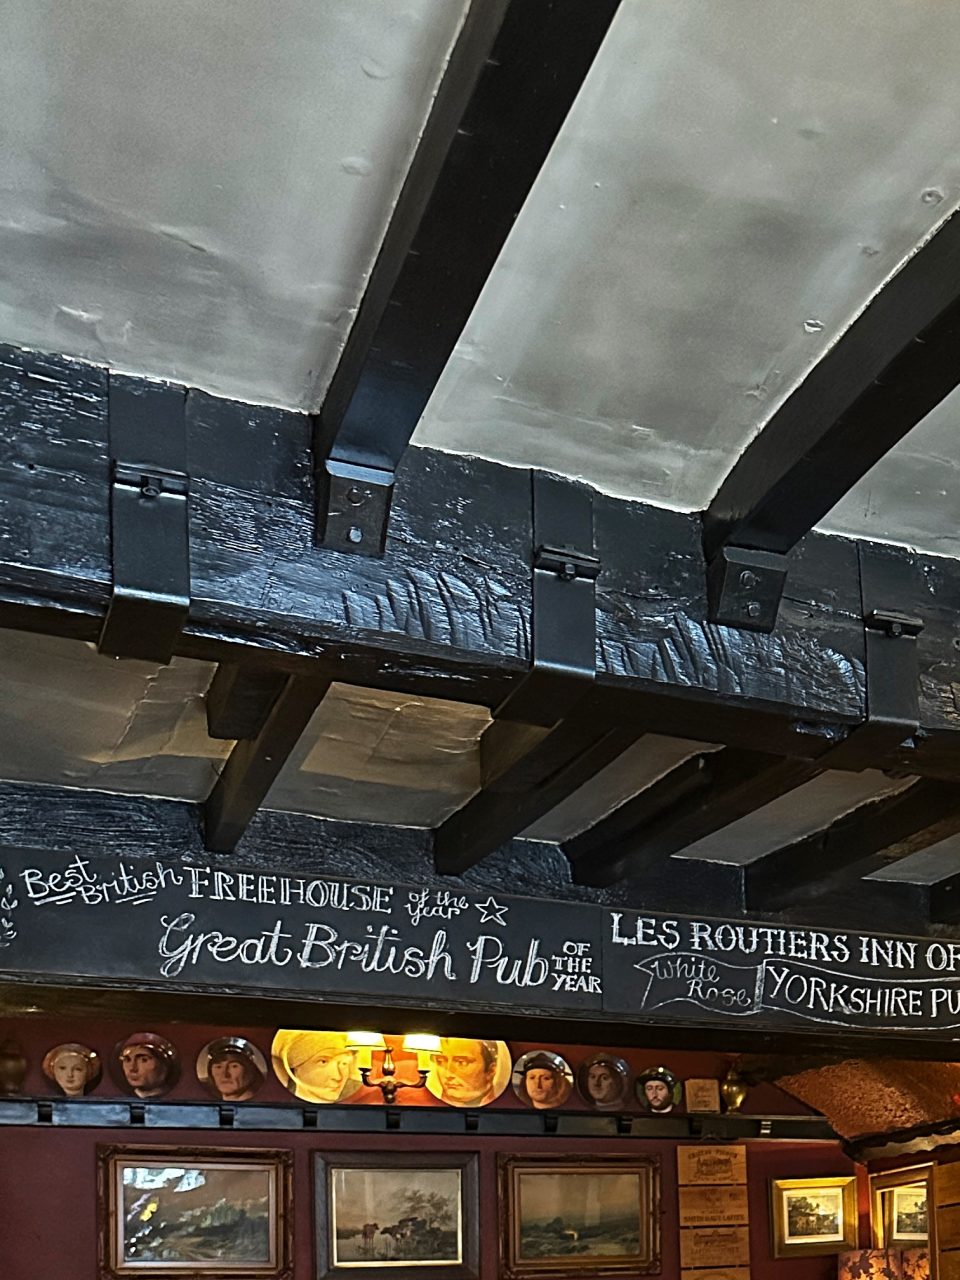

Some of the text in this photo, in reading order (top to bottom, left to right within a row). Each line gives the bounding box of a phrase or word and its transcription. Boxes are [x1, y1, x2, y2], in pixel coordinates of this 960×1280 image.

[20, 855, 394, 914] Best British FREEHOUSE
[408, 888, 469, 909] of the
[404, 901, 461, 926] year
[158, 913, 550, 987] Great British Pub
[563, 941, 591, 956] OF
[610, 912, 680, 949] LES
[689, 922, 851, 963] ROUTIERS
[859, 936, 919, 969] INN
[551, 955, 593, 974] THE
[650, 957, 721, 983] White
[550, 973, 603, 994] YEAR
[687, 979, 752, 1007] Rose
[766, 966, 923, 1017] YORKSHIRE
